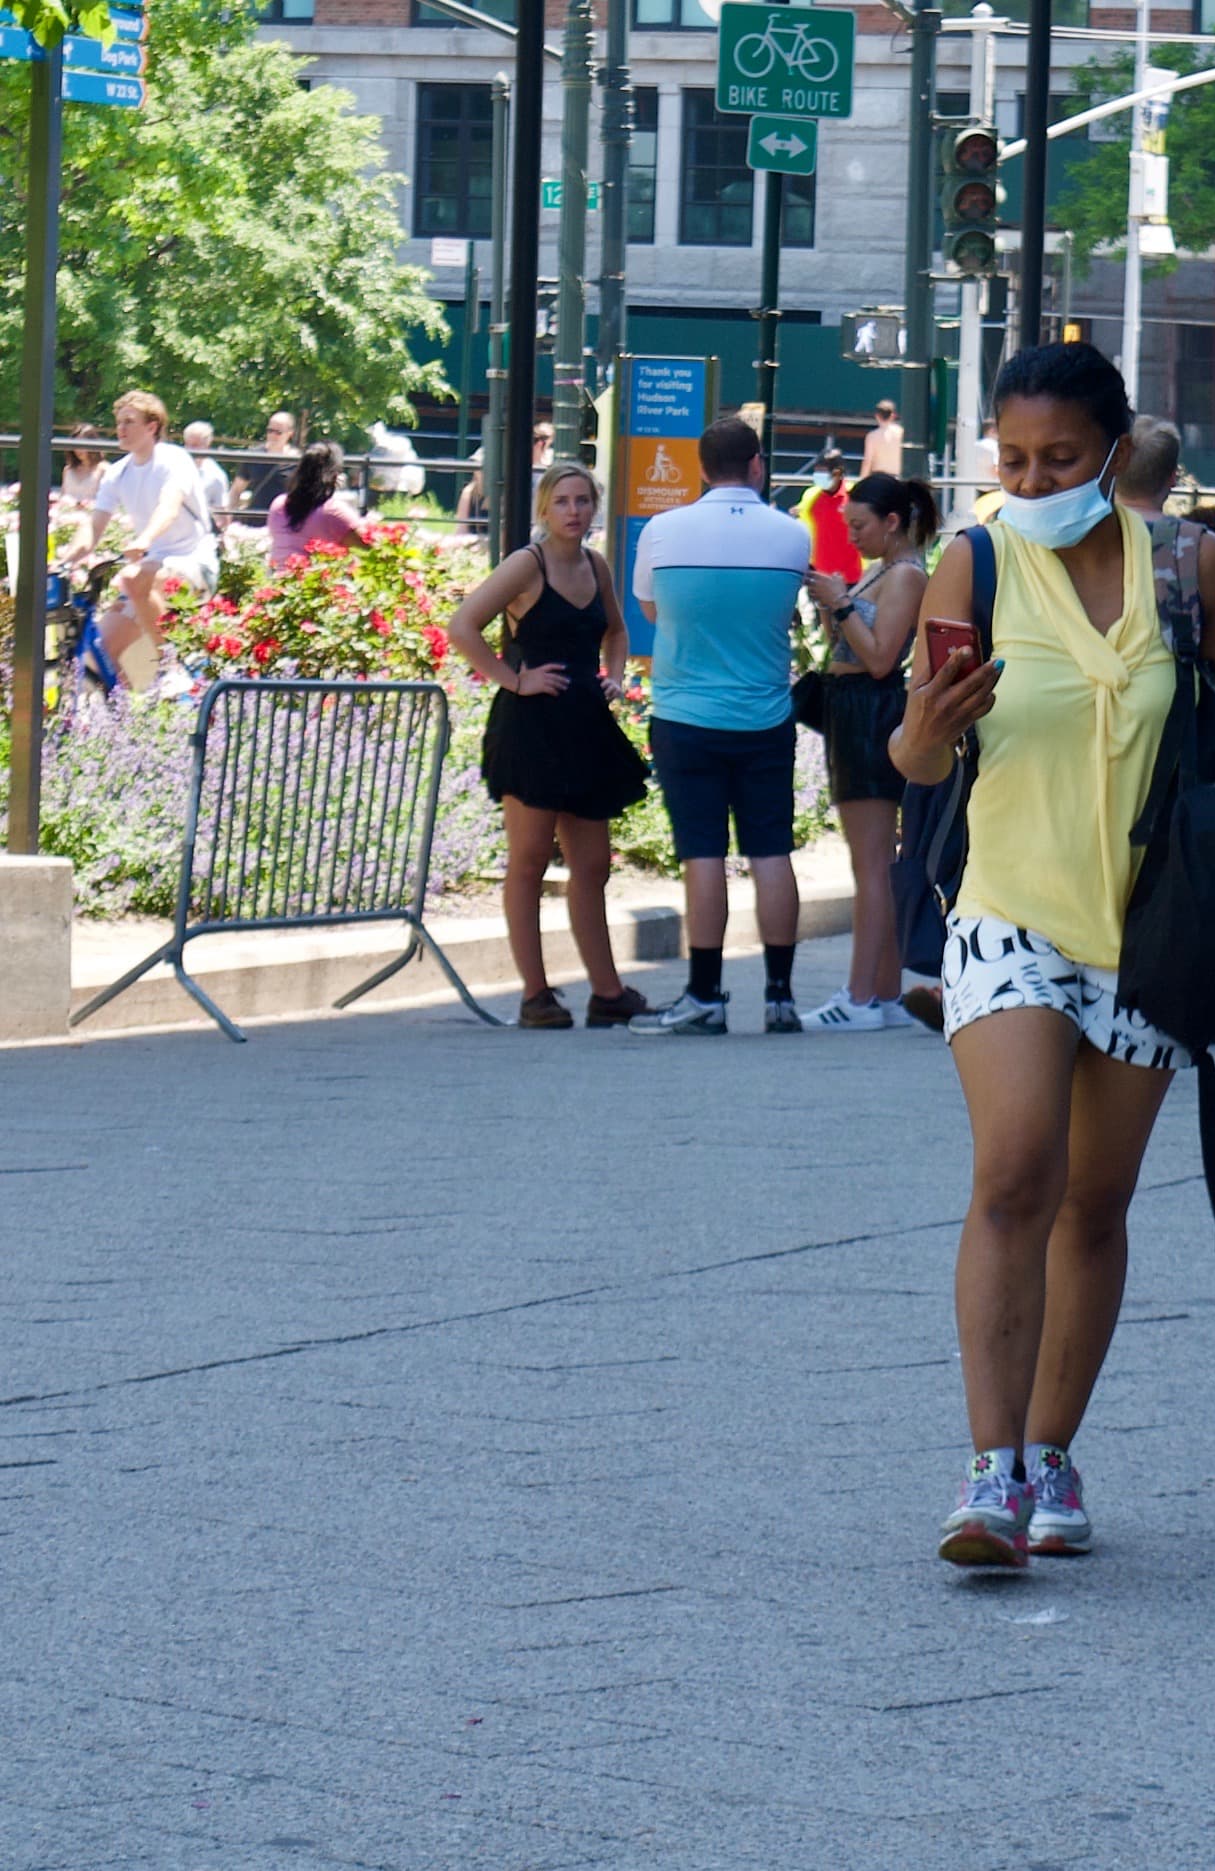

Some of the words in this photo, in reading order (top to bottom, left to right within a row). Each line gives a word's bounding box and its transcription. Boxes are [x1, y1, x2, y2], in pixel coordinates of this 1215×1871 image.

[728, 85, 768, 107] BIKE
[782, 89, 841, 112] ROUTE
[639, 366, 671, 377] Thank
[673, 369, 692, 379] you
[638, 379, 653, 389] for
[655, 380, 693, 393] visiting
[637, 392, 676, 402] Hudson
[637, 405, 663, 415] River
[665, 406, 689, 416] Park
[637, 487, 689, 496] DISMOUNT
